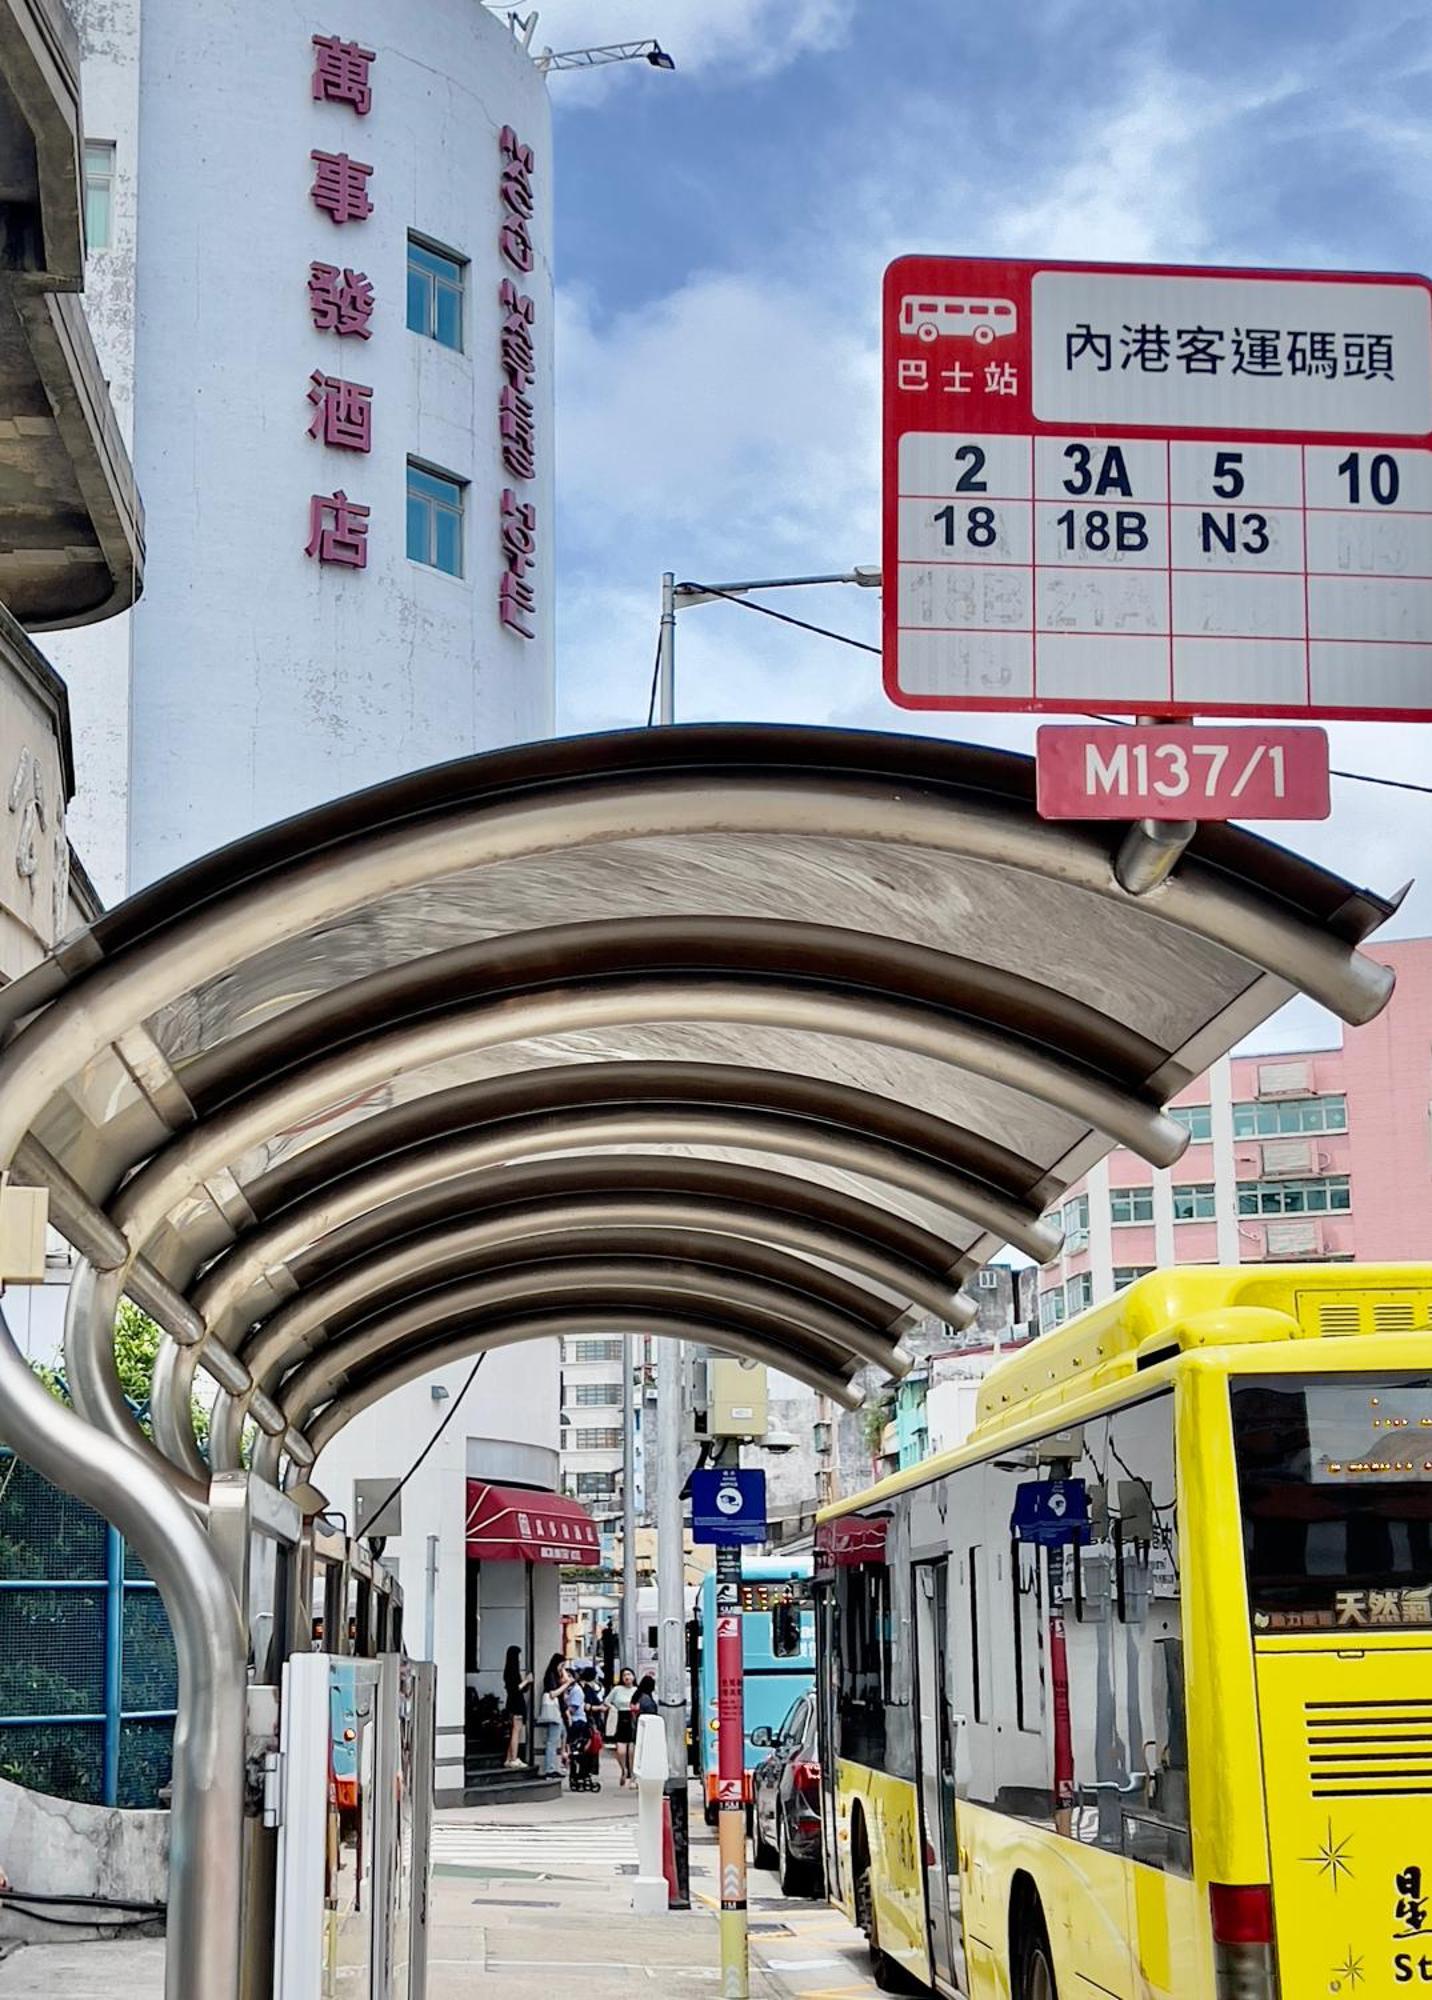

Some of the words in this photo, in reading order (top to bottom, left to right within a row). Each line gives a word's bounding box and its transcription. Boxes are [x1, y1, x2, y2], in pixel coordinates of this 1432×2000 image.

[304, 34, 377, 571] 萬事發酒店
[897, 359, 1019, 397] 巴士站
[1066, 323, 1395, 382] 內港客運碼頭
[954, 445, 988, 493] 2
[1062, 443, 1133, 498] 3A
[1212, 452, 1245, 499] 5
[1337, 452, 1400, 506] 10
[933, 506, 998, 547] 18
[1056, 509, 1149, 552] 18B
[1201, 512, 1270, 555] N3
[499, 488, 536, 640] HOTEL
[1084, 742, 1286, 799] M137/1
